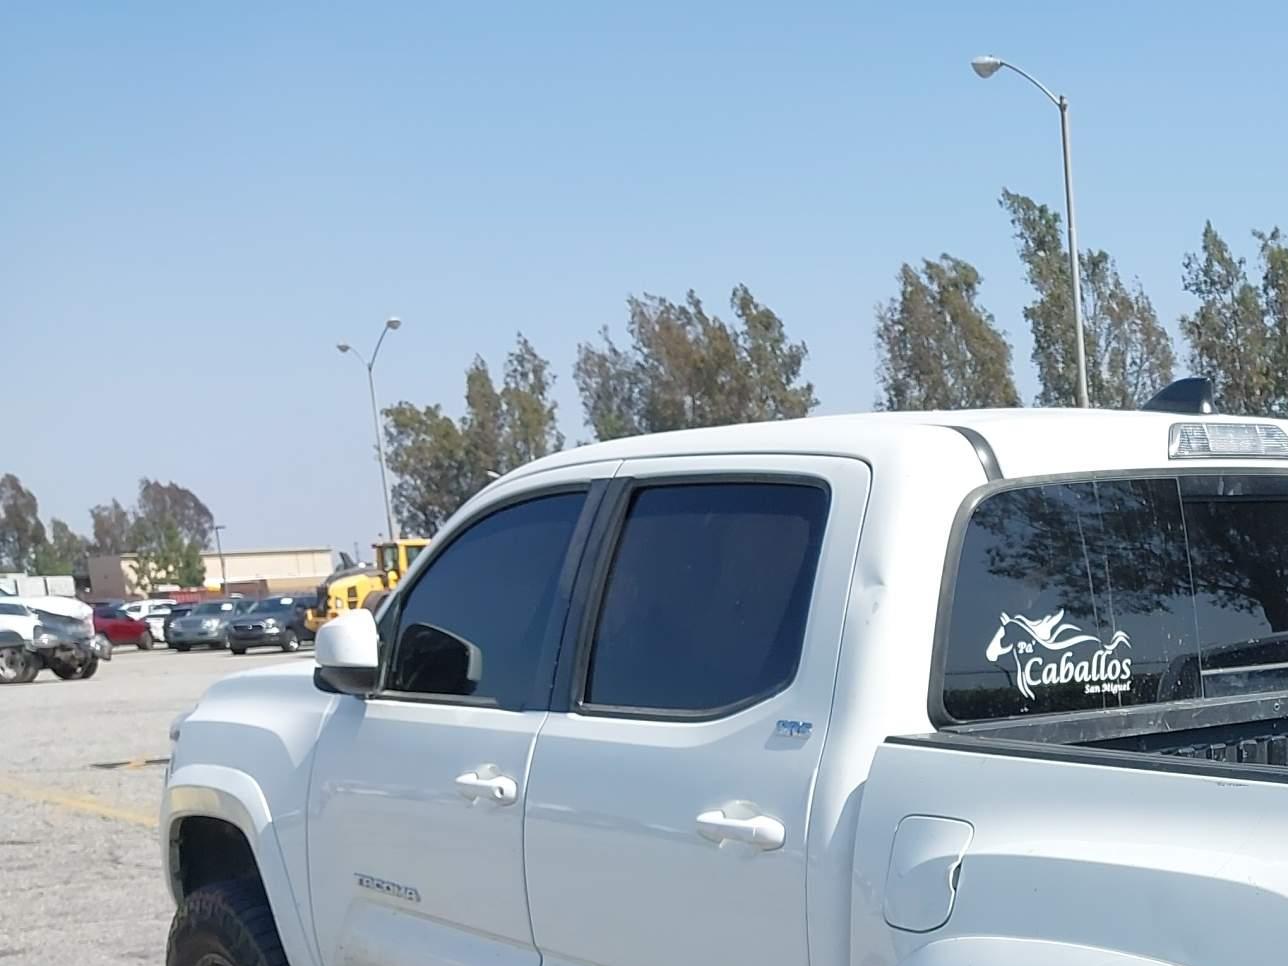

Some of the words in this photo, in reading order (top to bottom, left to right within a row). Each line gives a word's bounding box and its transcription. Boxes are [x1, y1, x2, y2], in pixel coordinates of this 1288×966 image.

[1023, 650, 1132, 686] Caballos
[1085, 683, 1101, 694] San
[1101, 680, 1132, 695] Miguel
[353, 872, 421, 902] TACOMA
